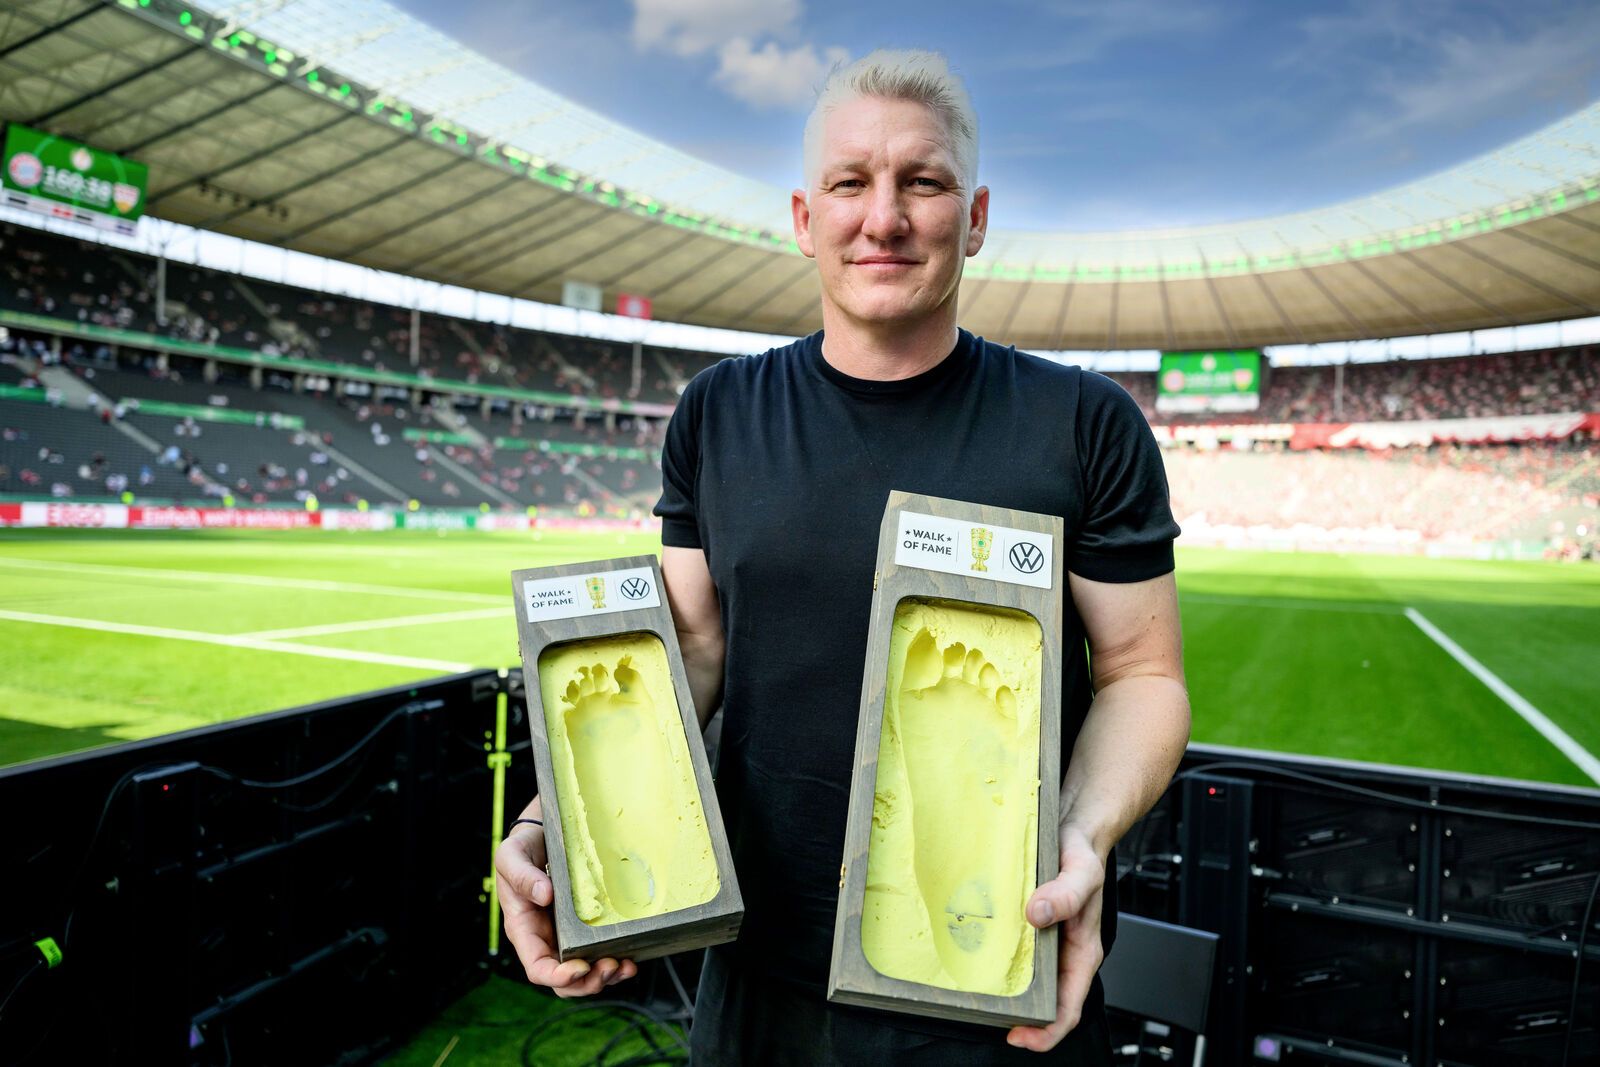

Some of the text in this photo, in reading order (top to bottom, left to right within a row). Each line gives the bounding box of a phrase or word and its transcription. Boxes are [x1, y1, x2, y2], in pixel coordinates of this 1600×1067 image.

[912, 529, 945, 542] WALK
[903, 540, 952, 556] OF FAME
[537, 590, 566, 599] WALK
[531, 598, 574, 609] OF FAME
